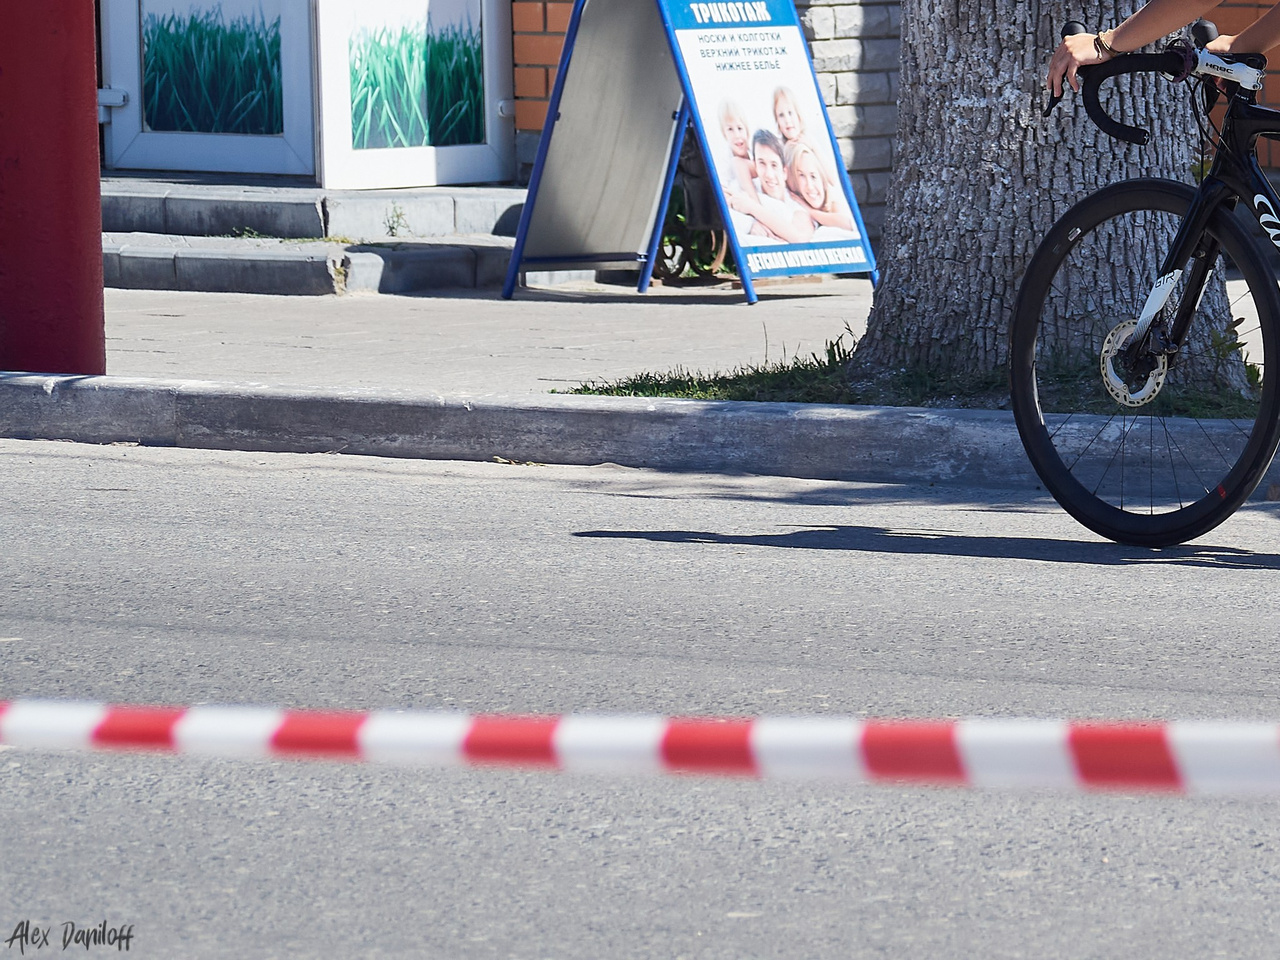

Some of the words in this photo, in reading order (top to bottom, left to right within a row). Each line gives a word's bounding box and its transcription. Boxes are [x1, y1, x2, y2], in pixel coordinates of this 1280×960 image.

[690, 1, 771, 23] ТРИКОТАЖ
[698, 34, 727, 43] НОСКИ
[730, 34, 736, 42] И
[738, 32, 781, 42] КОЛГОТКИ
[700, 46, 741, 58] ВЕРХНИЙ
[742, 46, 788, 56] ТРИКОТАЖ
[715, 61, 751, 71] НИЖНЕЕ
